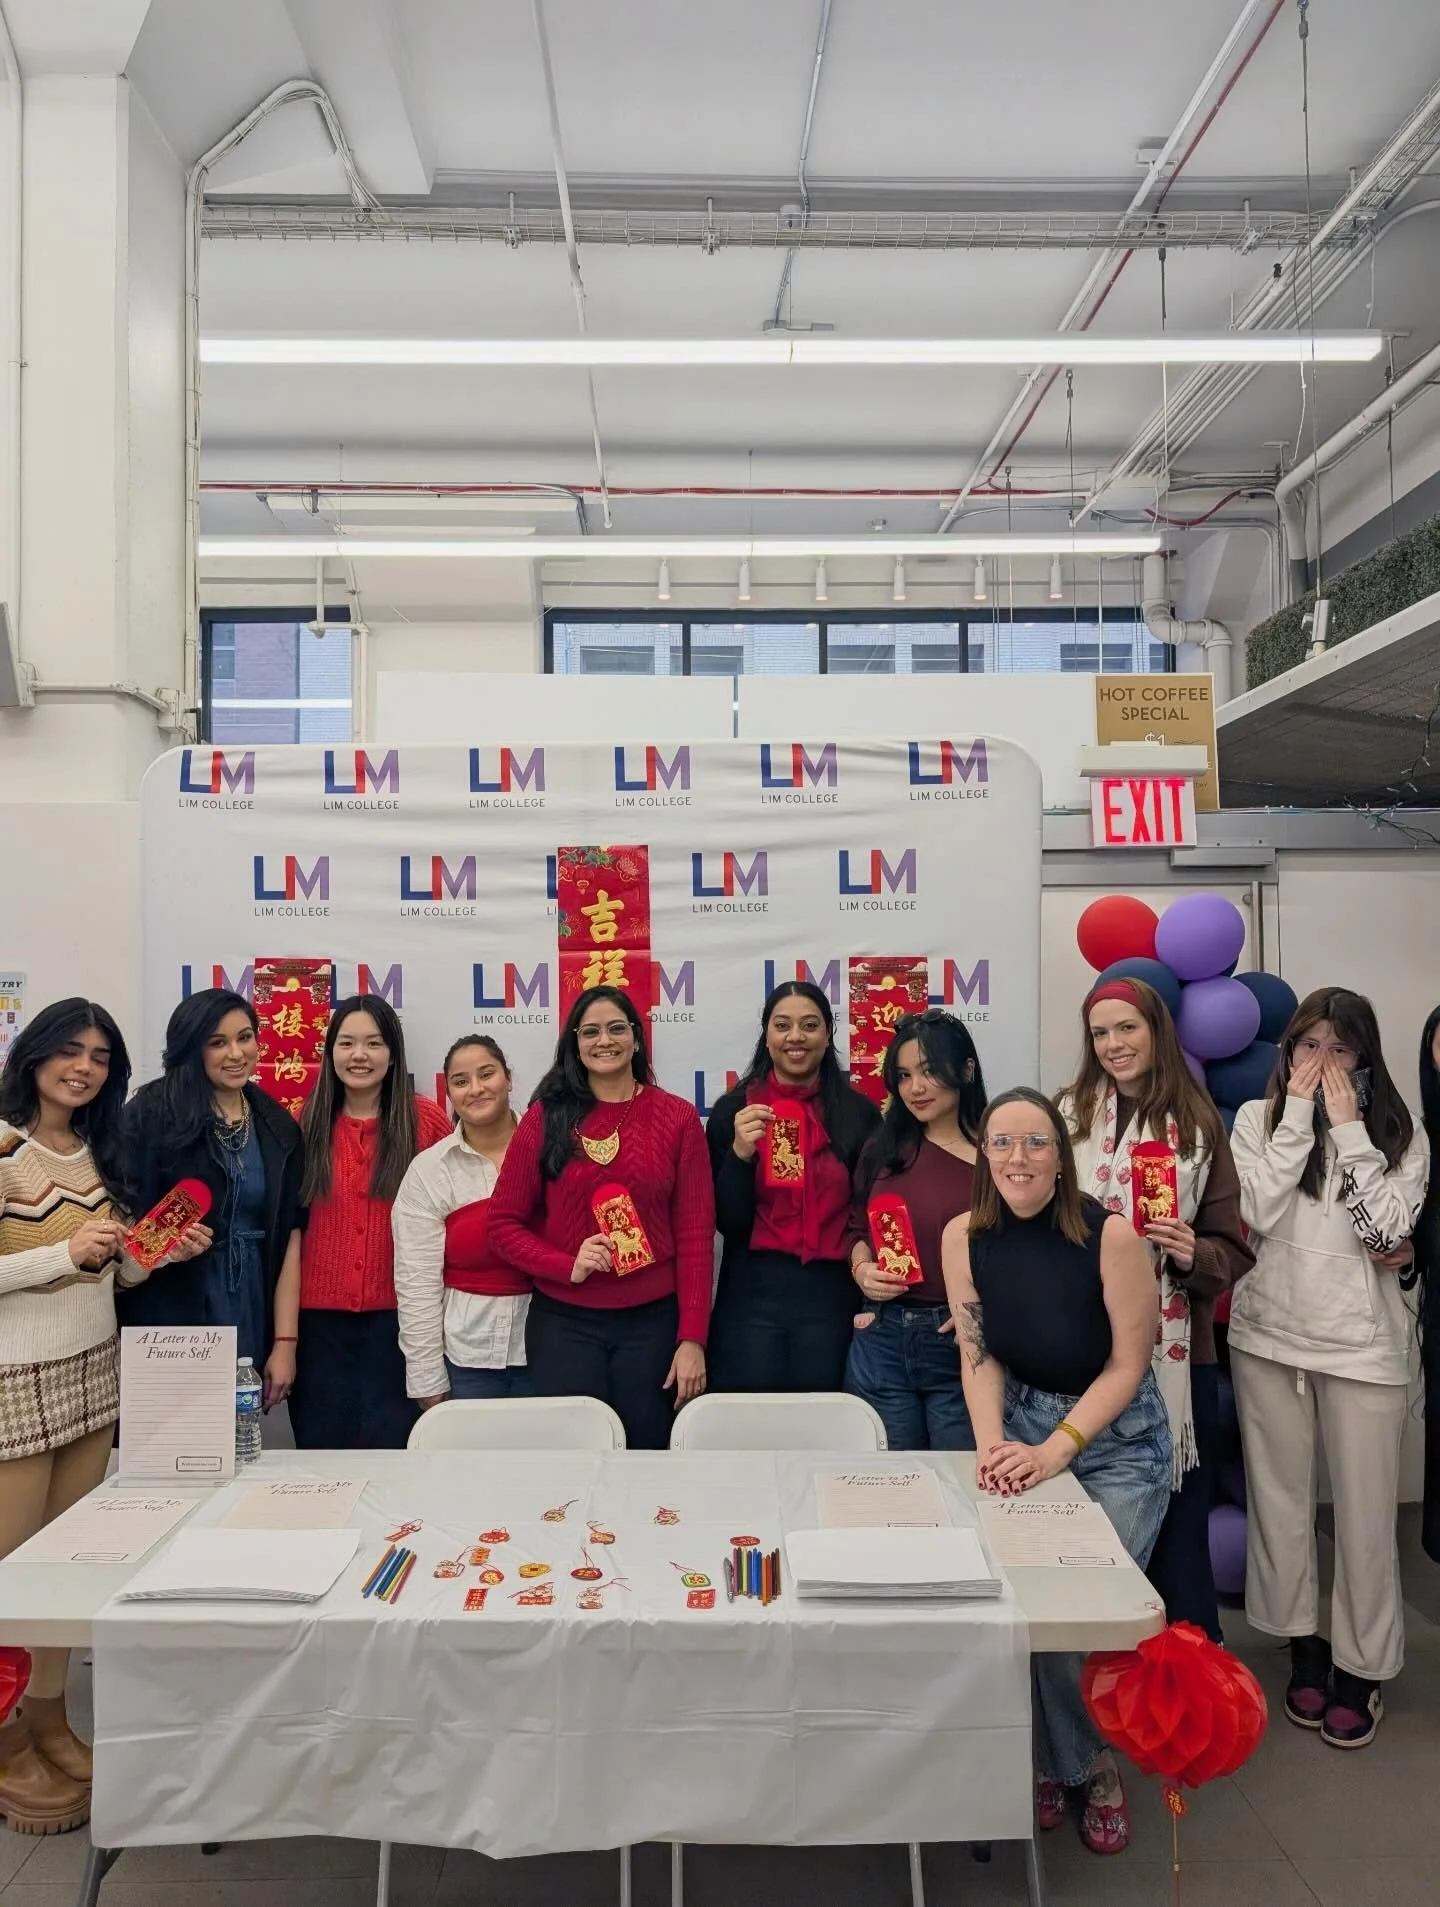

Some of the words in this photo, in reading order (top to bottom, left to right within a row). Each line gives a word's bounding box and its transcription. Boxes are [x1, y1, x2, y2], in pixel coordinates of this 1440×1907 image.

[1100, 688, 1135, 701] HOT
[1142, 687, 1209, 701] COFFEE
[1121, 707, 1190, 721] SPECIAL
[614, 745, 690, 791] LIM
[760, 743, 838, 788] LIM
[907, 738, 989, 785] LIM
[180, 750, 255, 794] LIM
[324, 750, 399, 794] LIM
[469, 748, 545, 792] LIM
[615, 797, 635, 807] LIM
[639, 796, 692, 807] COLLEGE
[761, 794, 781, 804] LIM
[785, 793, 839, 804] COLLEGE
[910, 791, 930, 801] LIM
[934, 789, 990, 801] COLLEGE
[178, 799, 198, 809] LIM
[202, 799, 255, 810] COLLEGE
[323, 800, 343, 810] LIM
[347, 800, 399, 810] COLLEGE
[469, 799, 489, 809] LIM
[493, 798, 546, 809] COLLEGE
[1102, 779, 1186, 843] EXIT
[254, 855, 330, 901] LIM
[400, 855, 477, 901] LIM
[692, 851, 769, 897] LIM
[839, 848, 917, 895] LIM
[254, 907, 274, 917] LIM
[277, 907, 331, 917] COLLEGE
[400, 906, 420, 916] LIM
[424, 906, 477, 916] COLLEGE
[692, 903, 713, 913] LIM
[716, 902, 769, 912] COLLEGE
[839, 901, 859, 911] LIM
[863, 900, 917, 911] COLLEGE
[473, 962, 549, 1009] LIM
[473, 1015, 494, 1025] LIM
[497, 1015, 550, 1025] COLLEGE
[650, 1012, 696, 1023] OLLEGE
[136, 1332, 149, 1344] A
[151, 1331, 187, 1344] Letter
[189, 1335, 200, 1344] to
[202, 1331, 223, 1347] My
[146, 1346, 186, 1359] Future
